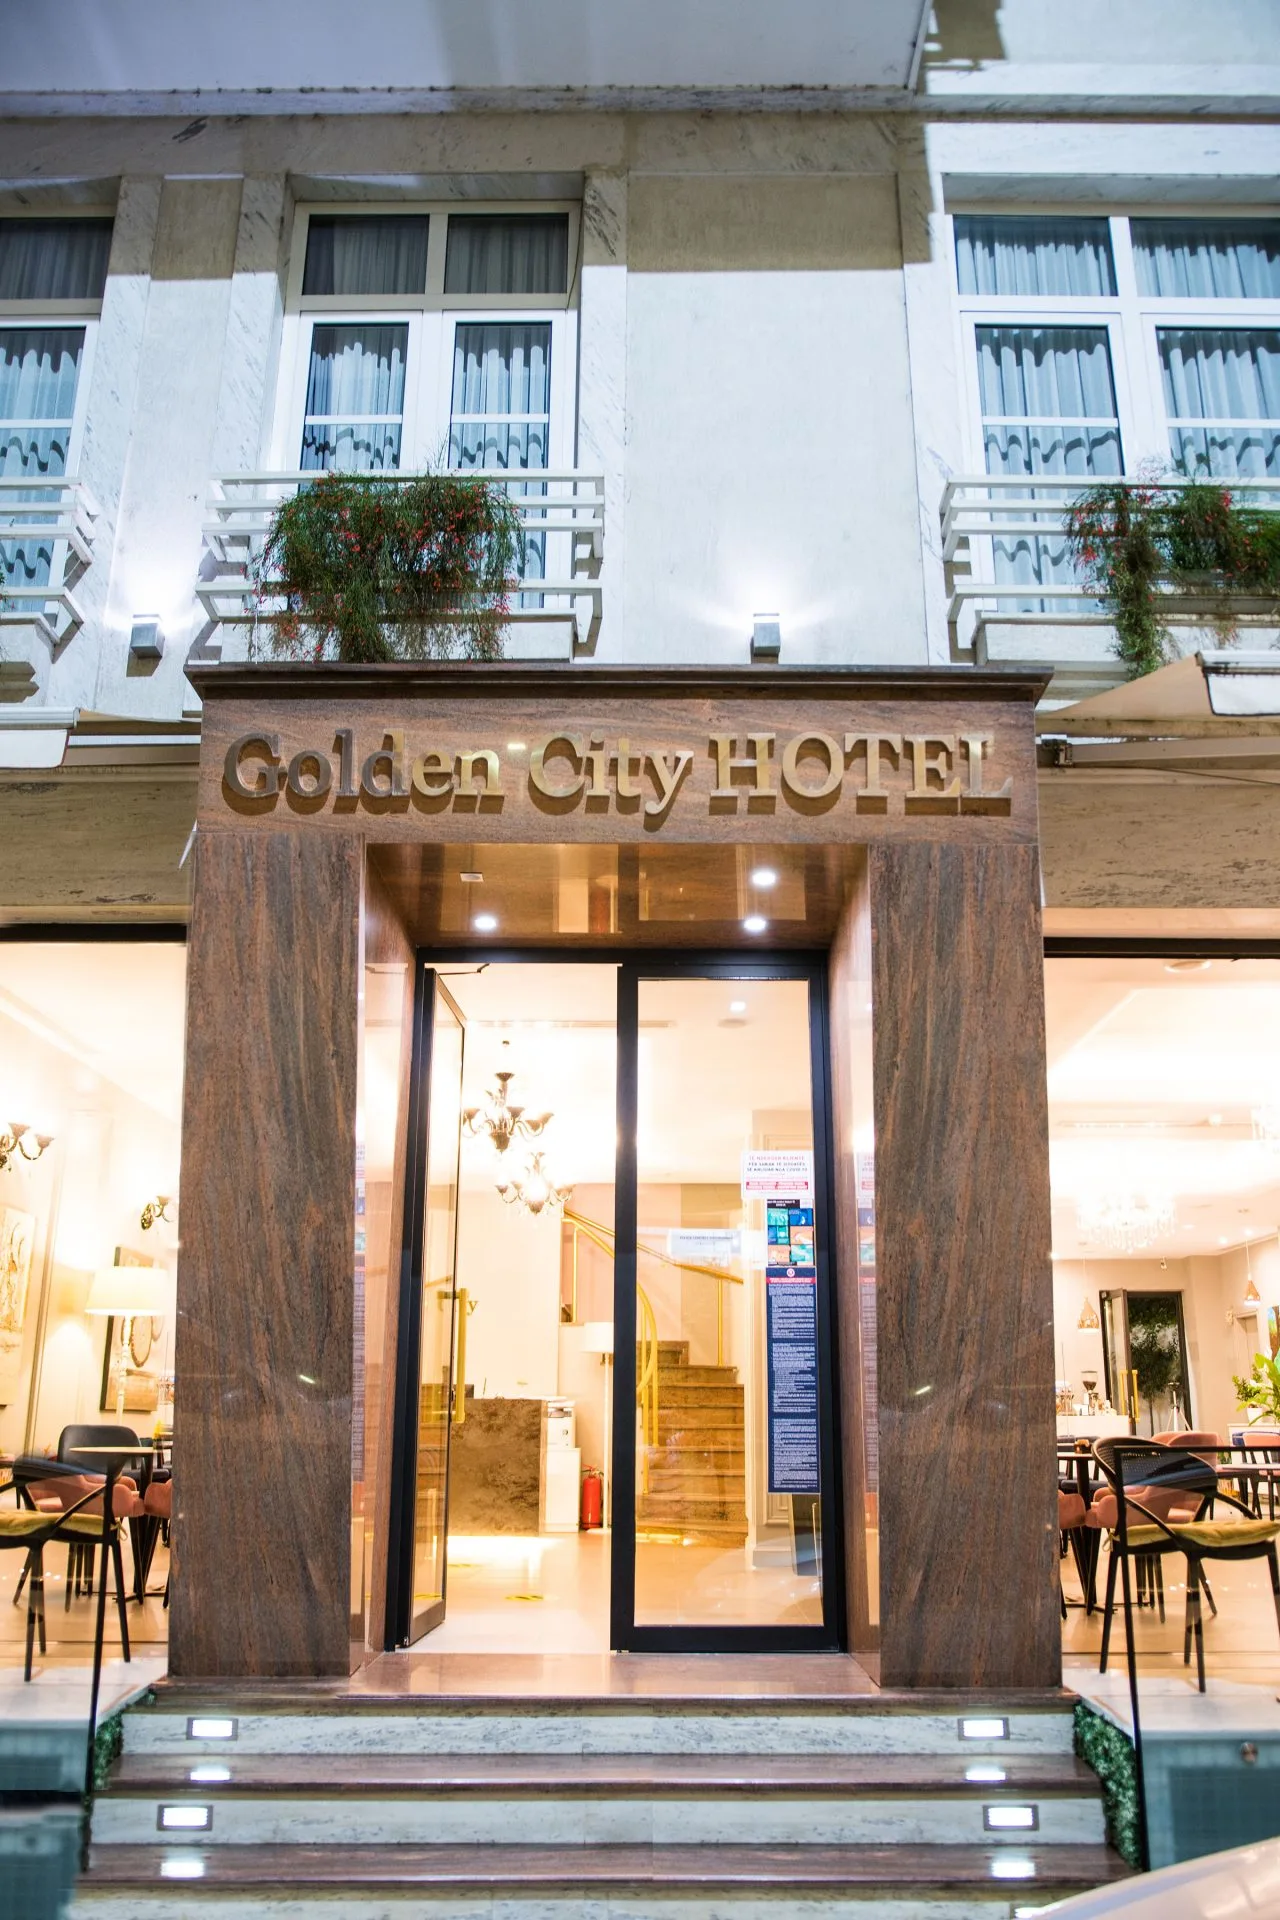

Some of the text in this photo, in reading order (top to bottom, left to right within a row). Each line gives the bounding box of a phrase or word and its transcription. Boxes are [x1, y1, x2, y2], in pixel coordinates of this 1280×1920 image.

[223, 728, 1014, 815] Golden City HOTEL
